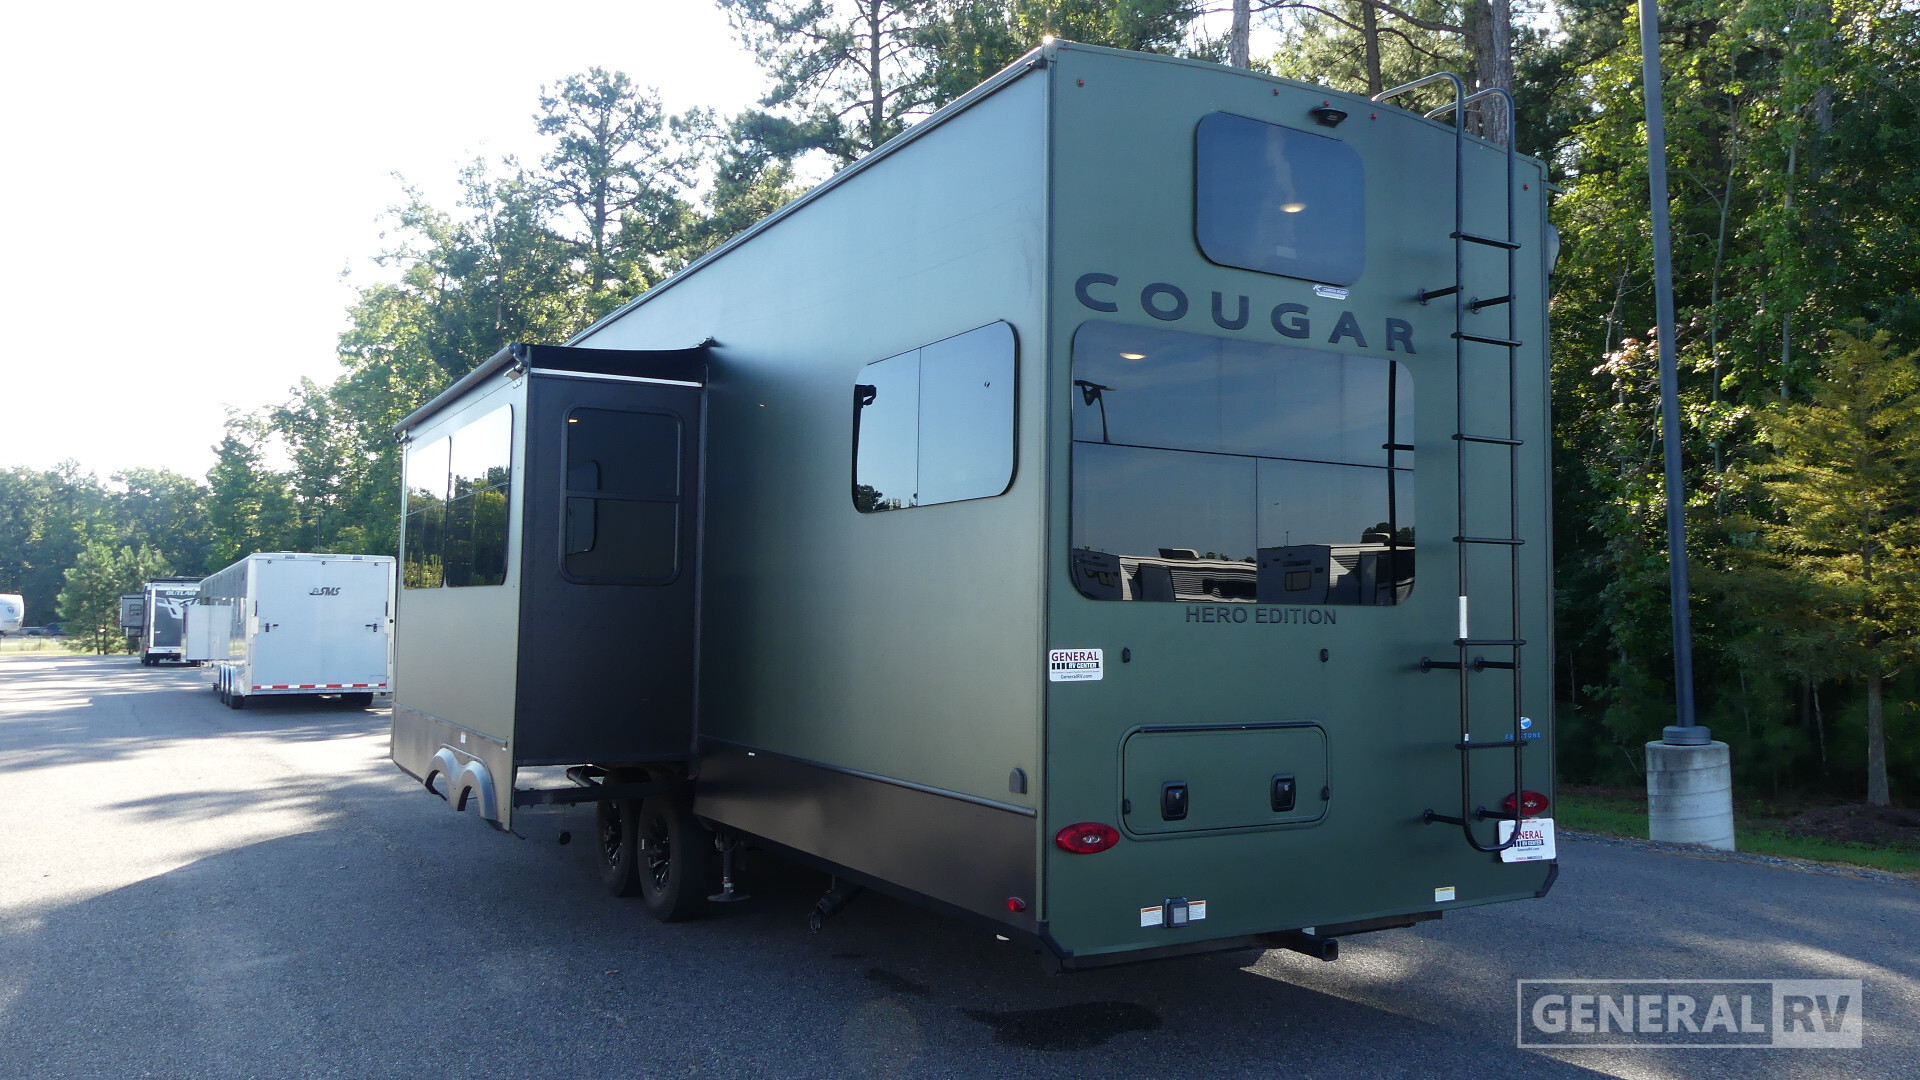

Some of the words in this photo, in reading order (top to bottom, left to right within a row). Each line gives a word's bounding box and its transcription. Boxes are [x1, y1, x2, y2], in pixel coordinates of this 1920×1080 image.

[1074, 272, 1417, 355] COUGAR
[1185, 605, 1248, 624] HERO
[1255, 607, 1337, 625] EDITION
[1051, 651, 1100, 662] GENERAL
[1504, 732, 1541, 740] KETONE
[1509, 829, 1544, 841] NERAL
